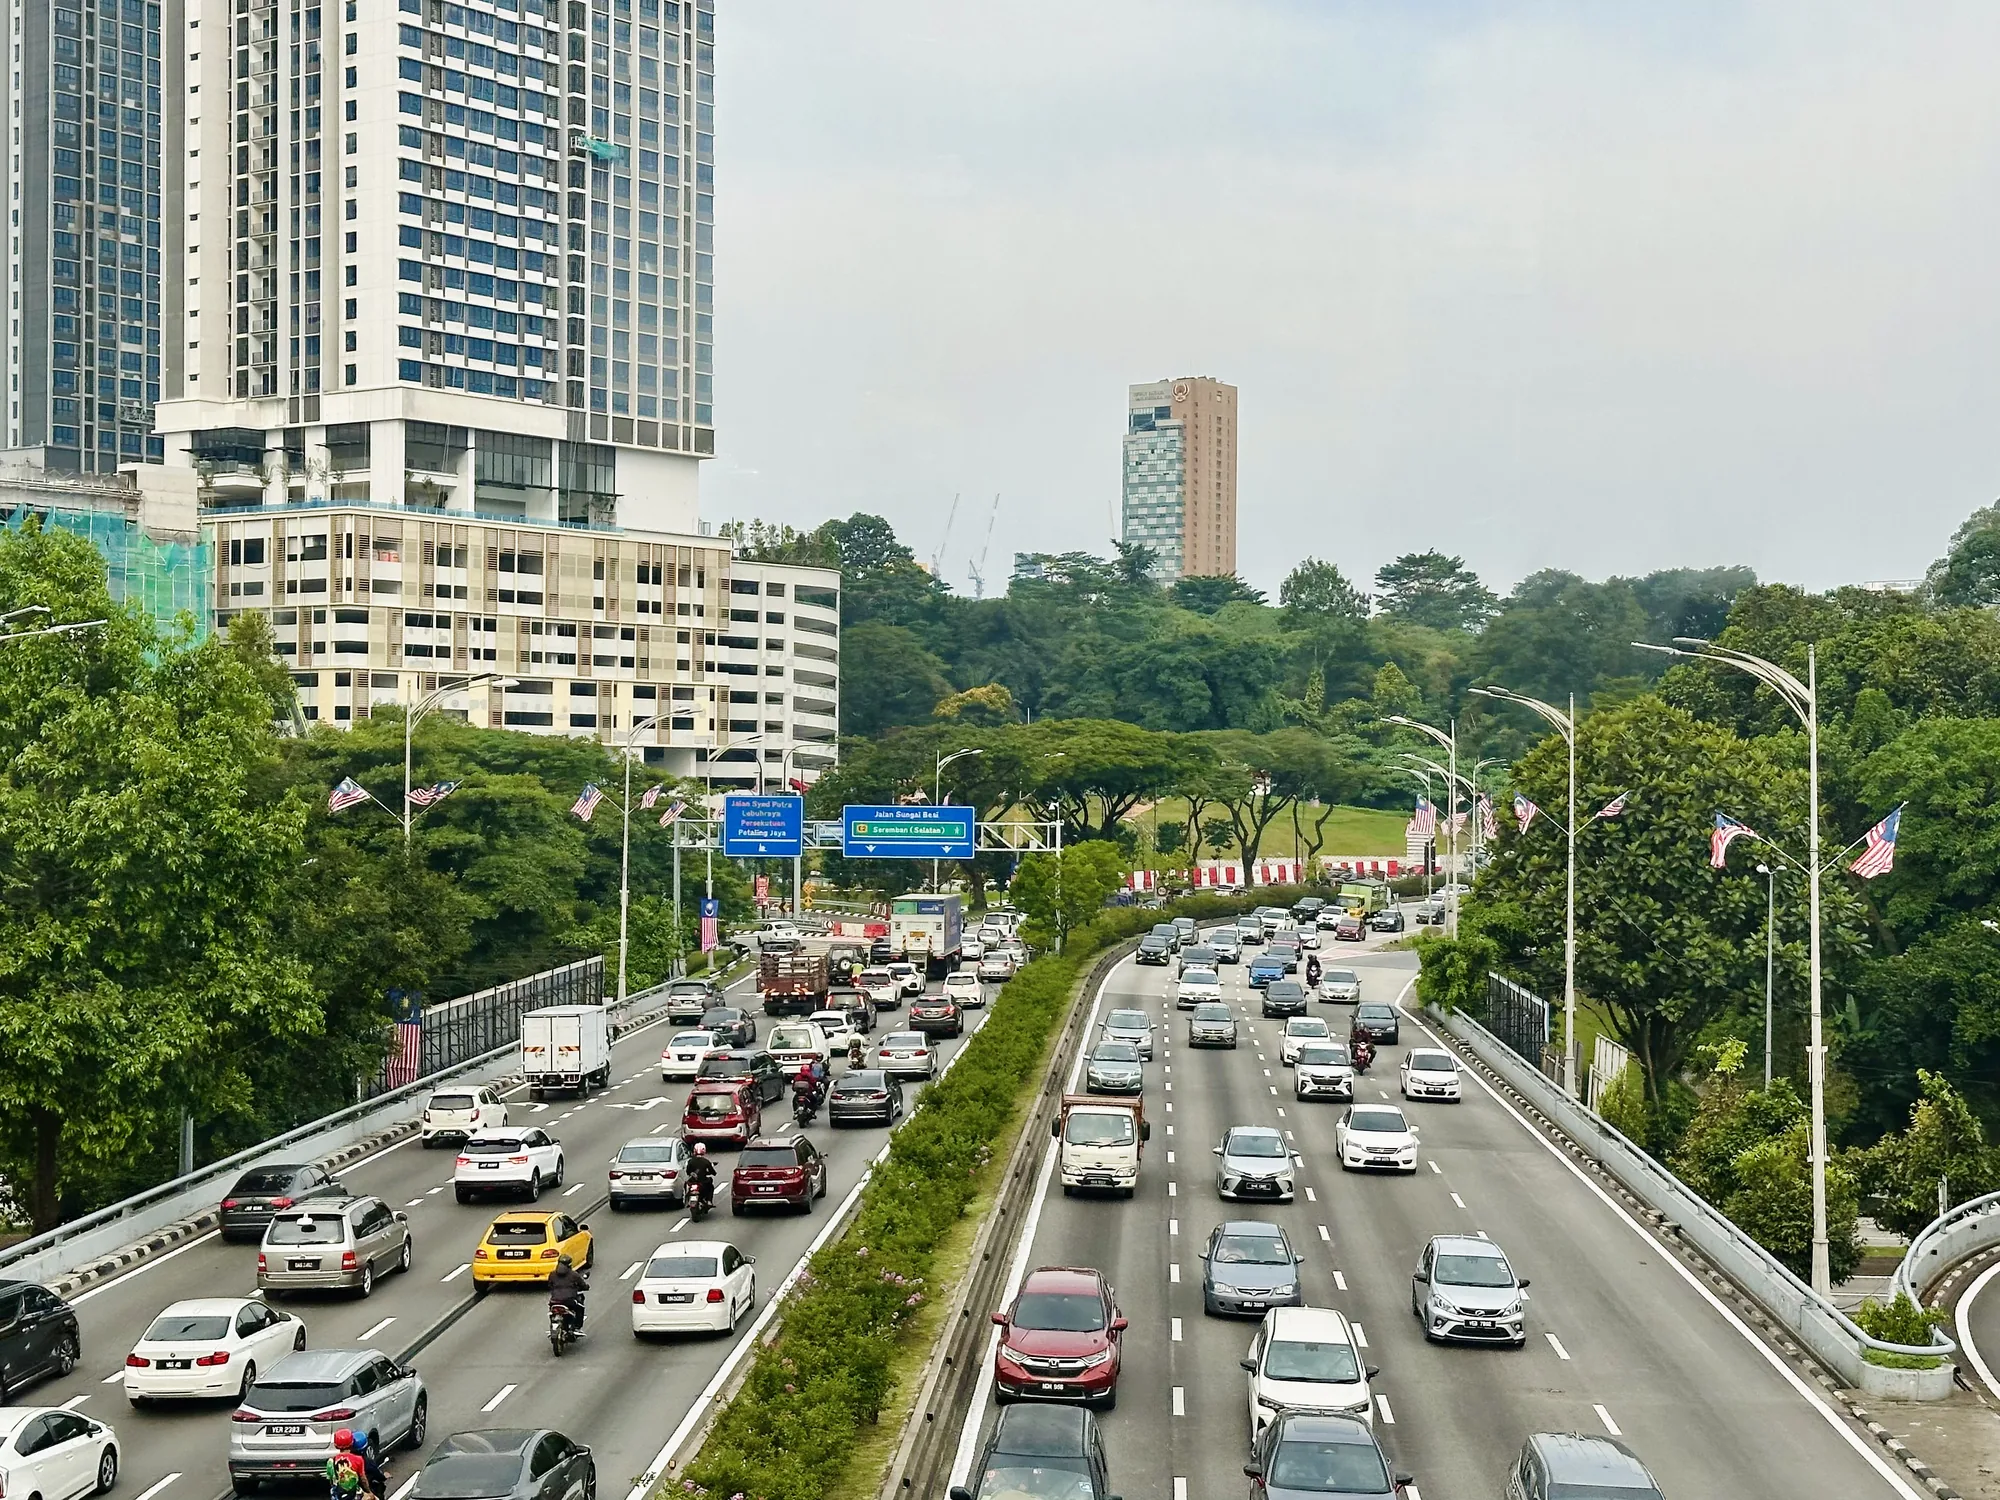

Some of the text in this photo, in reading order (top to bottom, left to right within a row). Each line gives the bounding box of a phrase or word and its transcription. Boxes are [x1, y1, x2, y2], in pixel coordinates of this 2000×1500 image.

[874, 810, 894, 818] Jalan
[895, 811, 921, 820] Sungai
[738, 829, 787, 837] Petaling Jaya
[872, 826, 909, 834] Seremban
